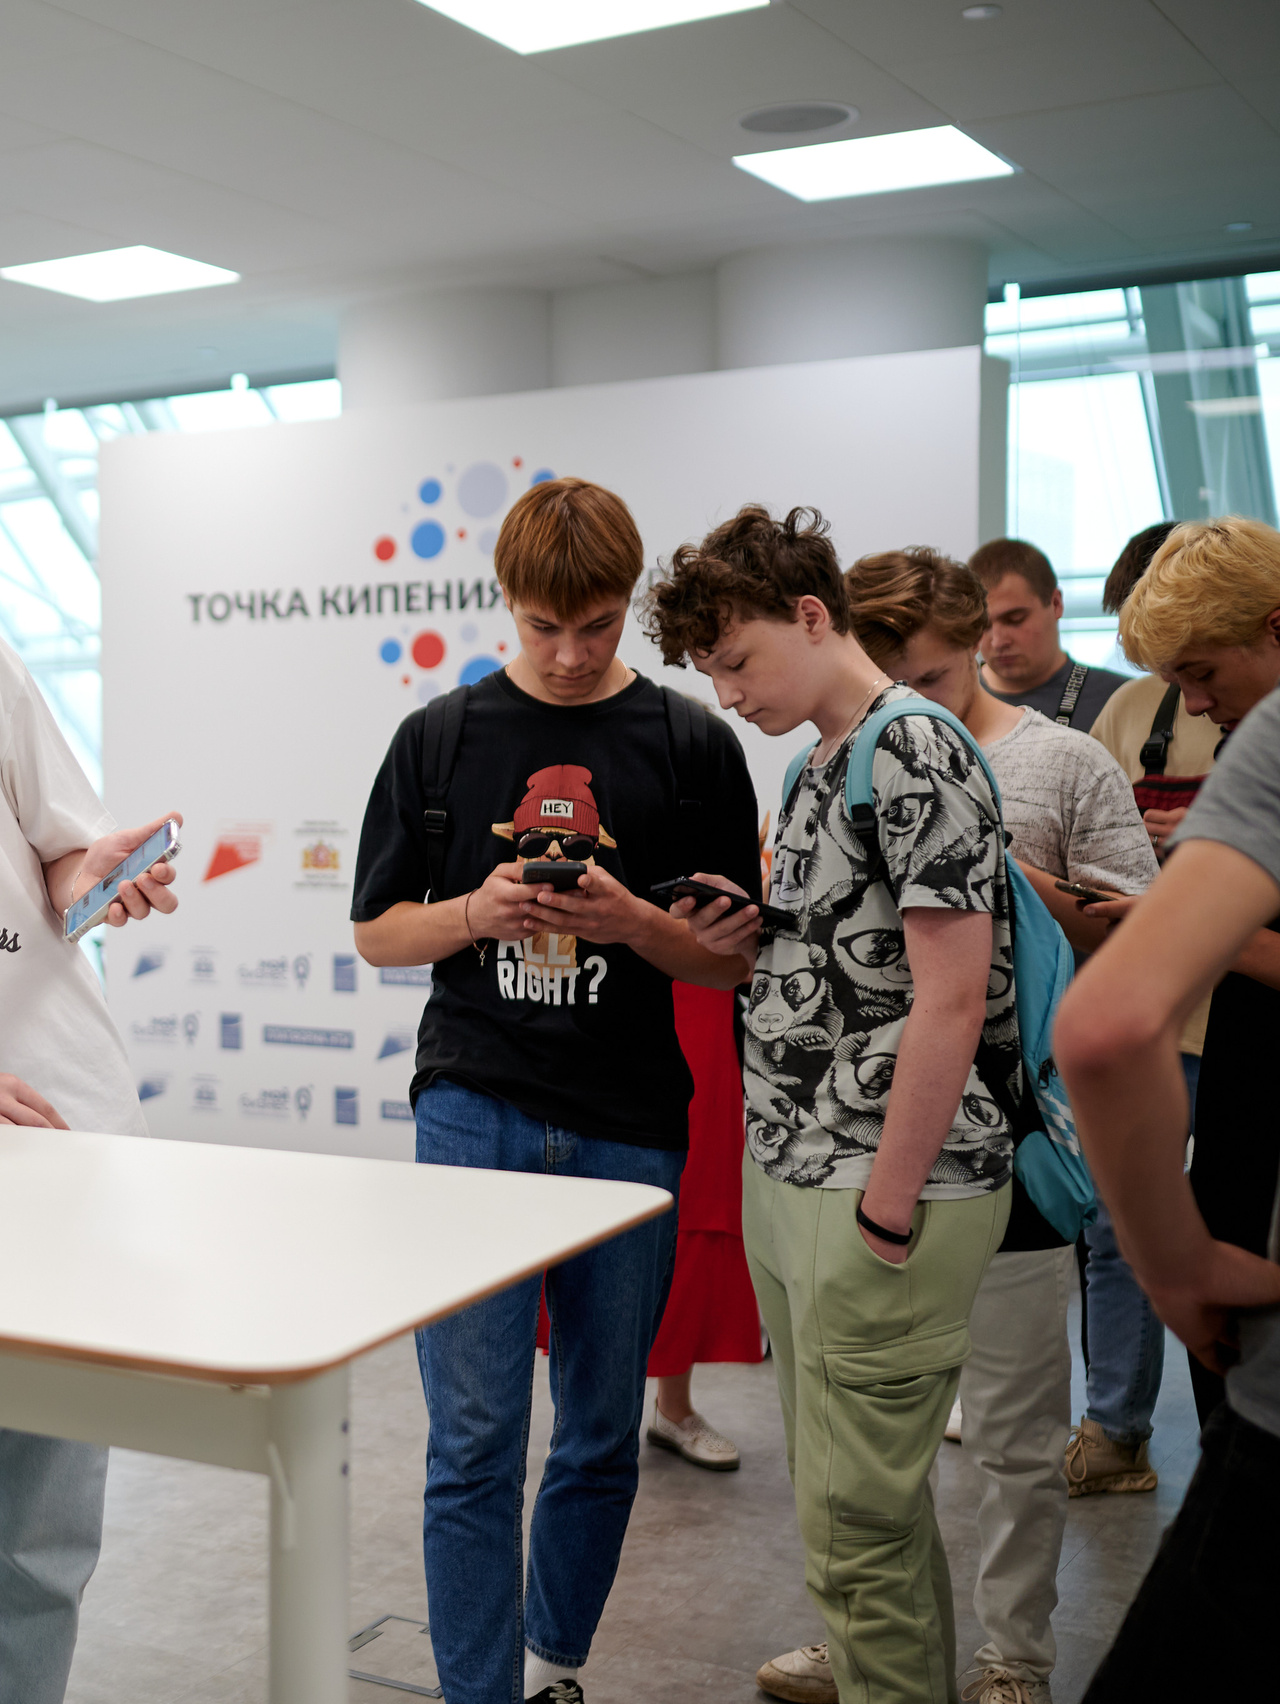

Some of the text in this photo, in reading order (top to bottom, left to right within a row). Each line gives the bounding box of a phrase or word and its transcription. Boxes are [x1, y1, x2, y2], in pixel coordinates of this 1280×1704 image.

[187, 588, 311, 622] ТОЧКА
[543, 802, 571, 814] HEY
[497, 955, 608, 1006] RIGHT?
